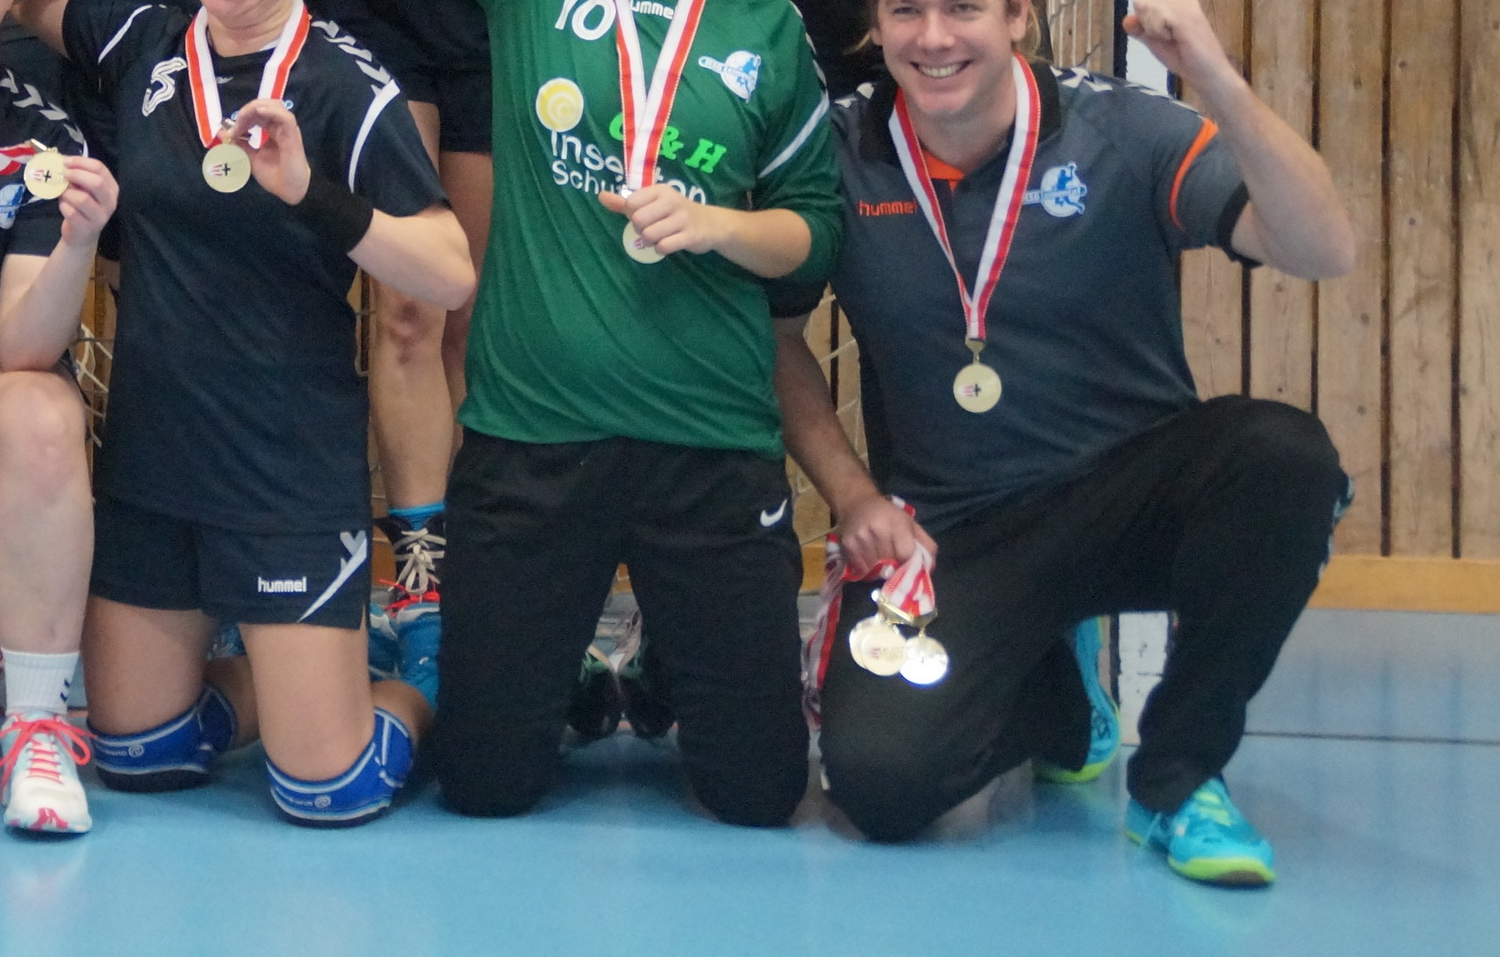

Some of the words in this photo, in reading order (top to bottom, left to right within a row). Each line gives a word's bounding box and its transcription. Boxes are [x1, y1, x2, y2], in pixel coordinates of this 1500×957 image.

[630, 0, 677, 20] umme
[142, 57, 187, 117] 5
[685, 138, 726, 173] H
[858, 199, 917, 217] hummel
[257, 576, 307, 593] hummel
